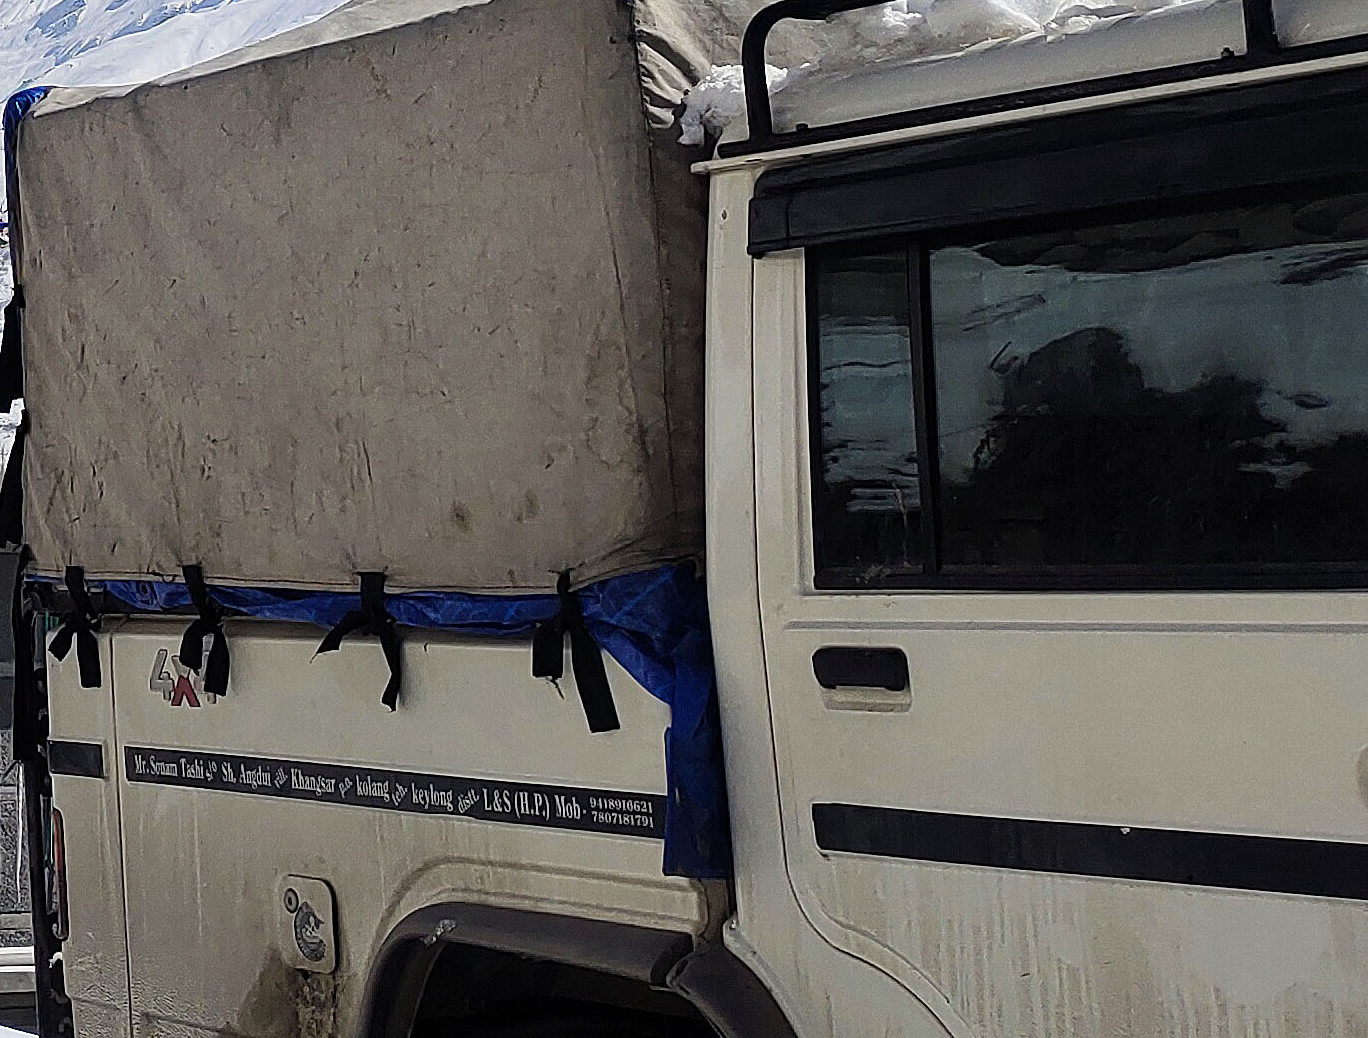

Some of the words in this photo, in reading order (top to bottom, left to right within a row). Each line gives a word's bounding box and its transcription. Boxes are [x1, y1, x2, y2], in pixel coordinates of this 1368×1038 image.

[134, 754, 149, 775] Mr.
[179, 758, 205, 779] Tashi
[221, 761, 236, 784] Sh.
[239, 763, 271, 790] Angdui
[291, 767, 335, 795] Khangsar
[356, 775, 390, 802] kolang
[412, 782, 453, 811] keylong
[482, 787, 511, 813] L&S
[514, 790, 550, 821] (H.P.)
[590, 811, 655, 829] 7807181791
